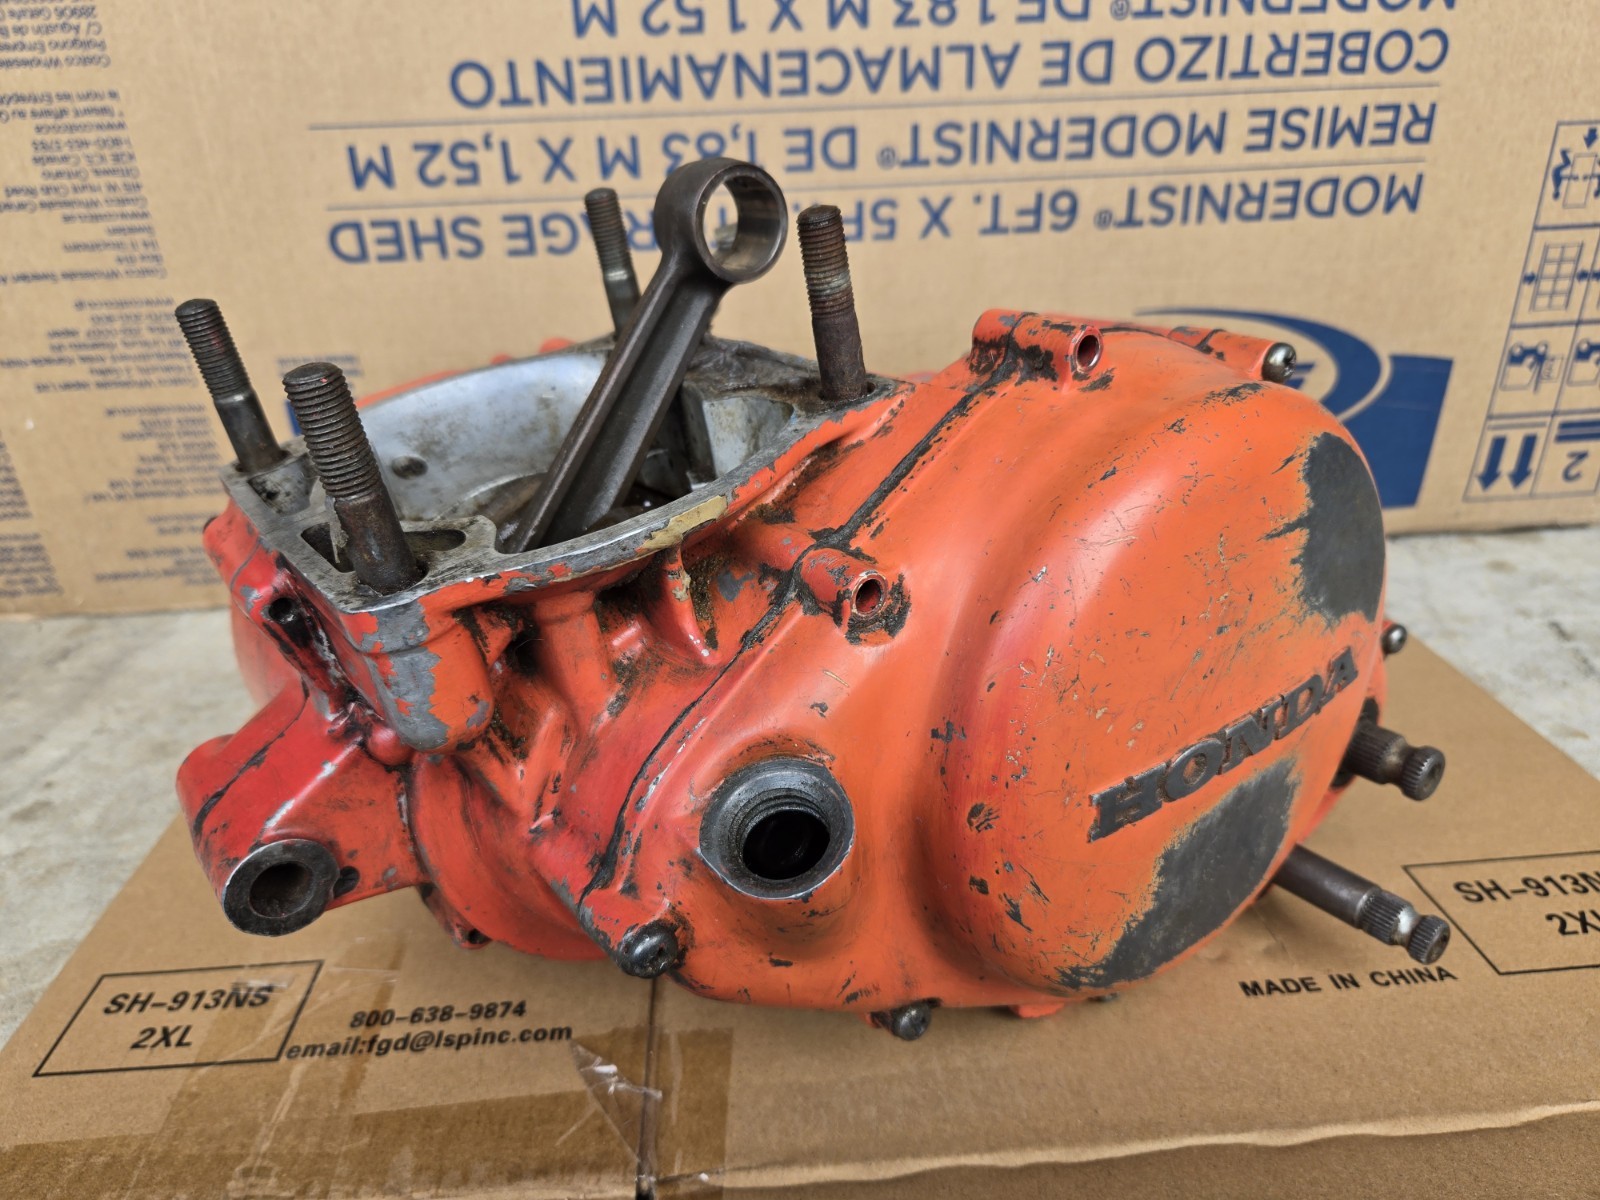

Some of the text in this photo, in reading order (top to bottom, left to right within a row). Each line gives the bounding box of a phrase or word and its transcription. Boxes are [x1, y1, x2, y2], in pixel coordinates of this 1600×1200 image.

[448, 28, 1451, 110] COBERTIZO DE ALMACENAMIENTO
[783, 125, 859, 174] DE
[1243, 102, 1438, 154] REMISE
[345, 143, 396, 192] M
[412, 133, 522, 189] 1,52
[537, 136, 575, 184] X
[597, 135, 641, 182] M
[917, 195, 953, 240] X
[972, 189, 1080, 236] 6FT.
[327, 213, 484, 265] SHED
[1562, 449, 1589, 484] 2
[1088, 645, 1359, 843] HONDA
[103, 984, 275, 1016] SH-913NS
[1239, 965, 1458, 998] MADE IN CHINA
[130, 1024, 194, 1050] 2XL
[349, 999, 527, 1028] 800-638-9874
[286, 1025, 573, 1060] email:fgd@lspinc.com
